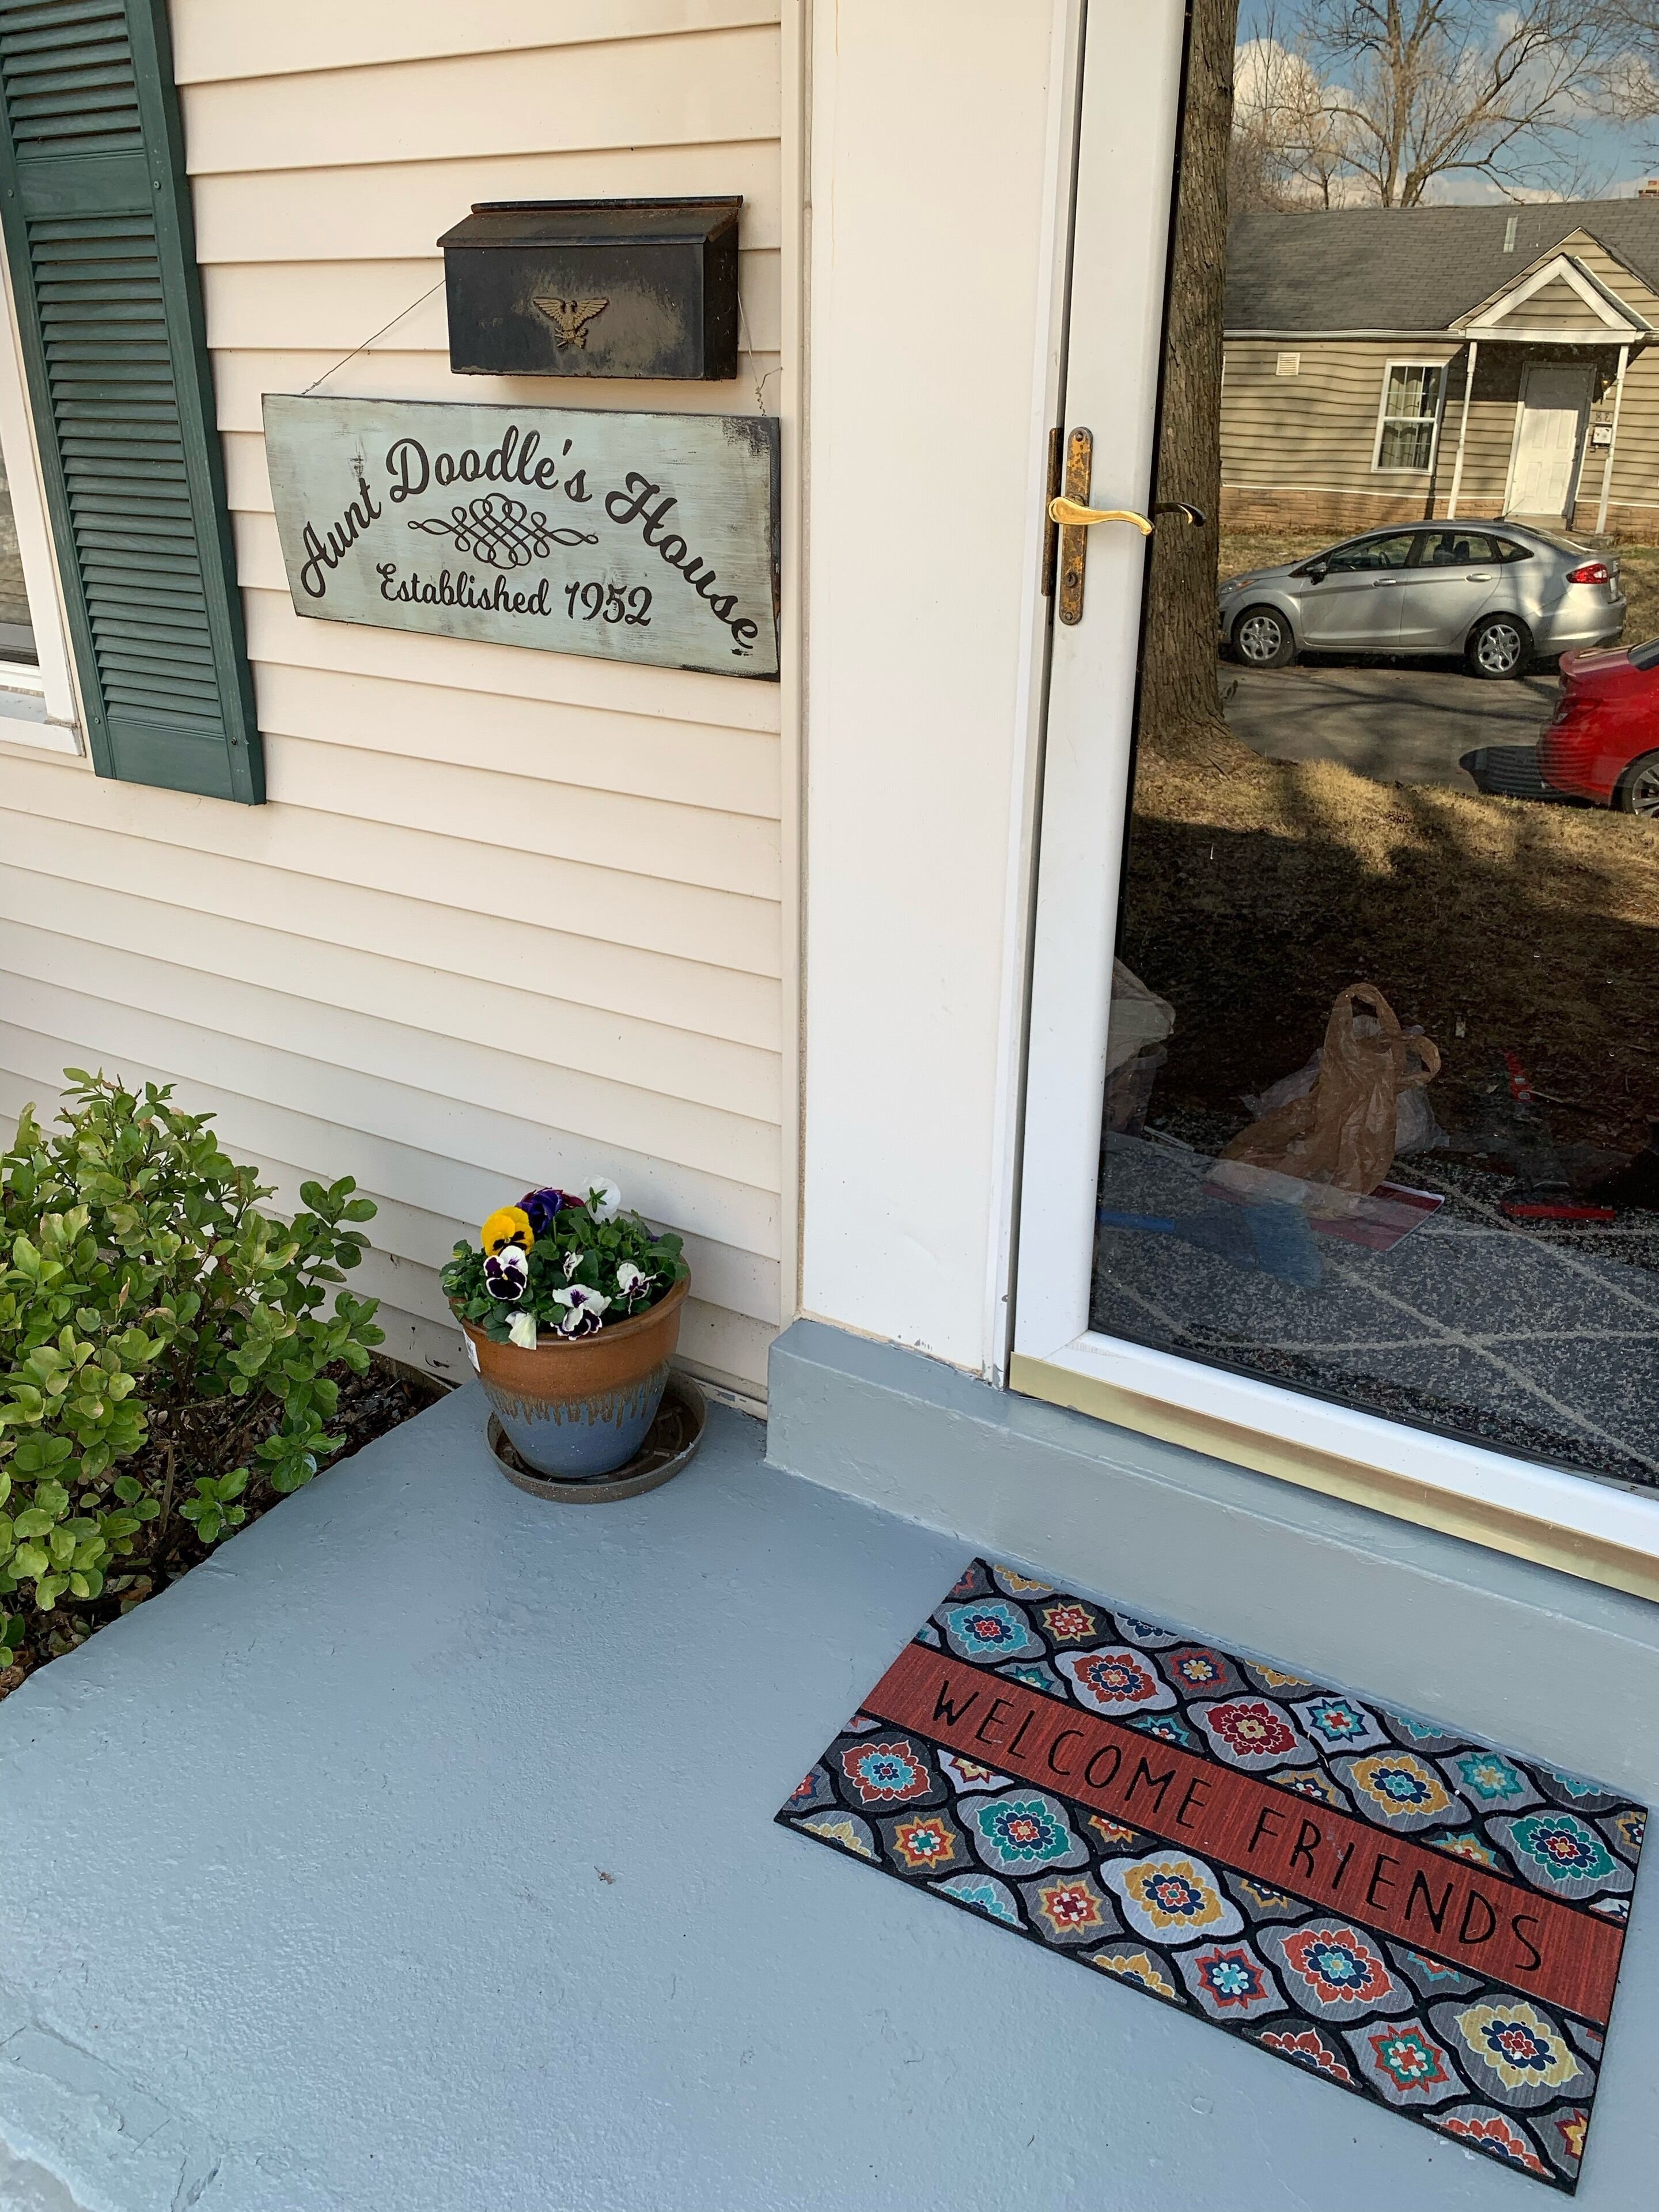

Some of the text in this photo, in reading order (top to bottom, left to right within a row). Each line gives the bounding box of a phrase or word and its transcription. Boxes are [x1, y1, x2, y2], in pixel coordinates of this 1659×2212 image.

[301, 425, 759, 649] Aunt Doodle's House
[376, 562, 652, 626] Established 1952
[932, 1679, 1543, 1972] WELCOME FRIENDS
